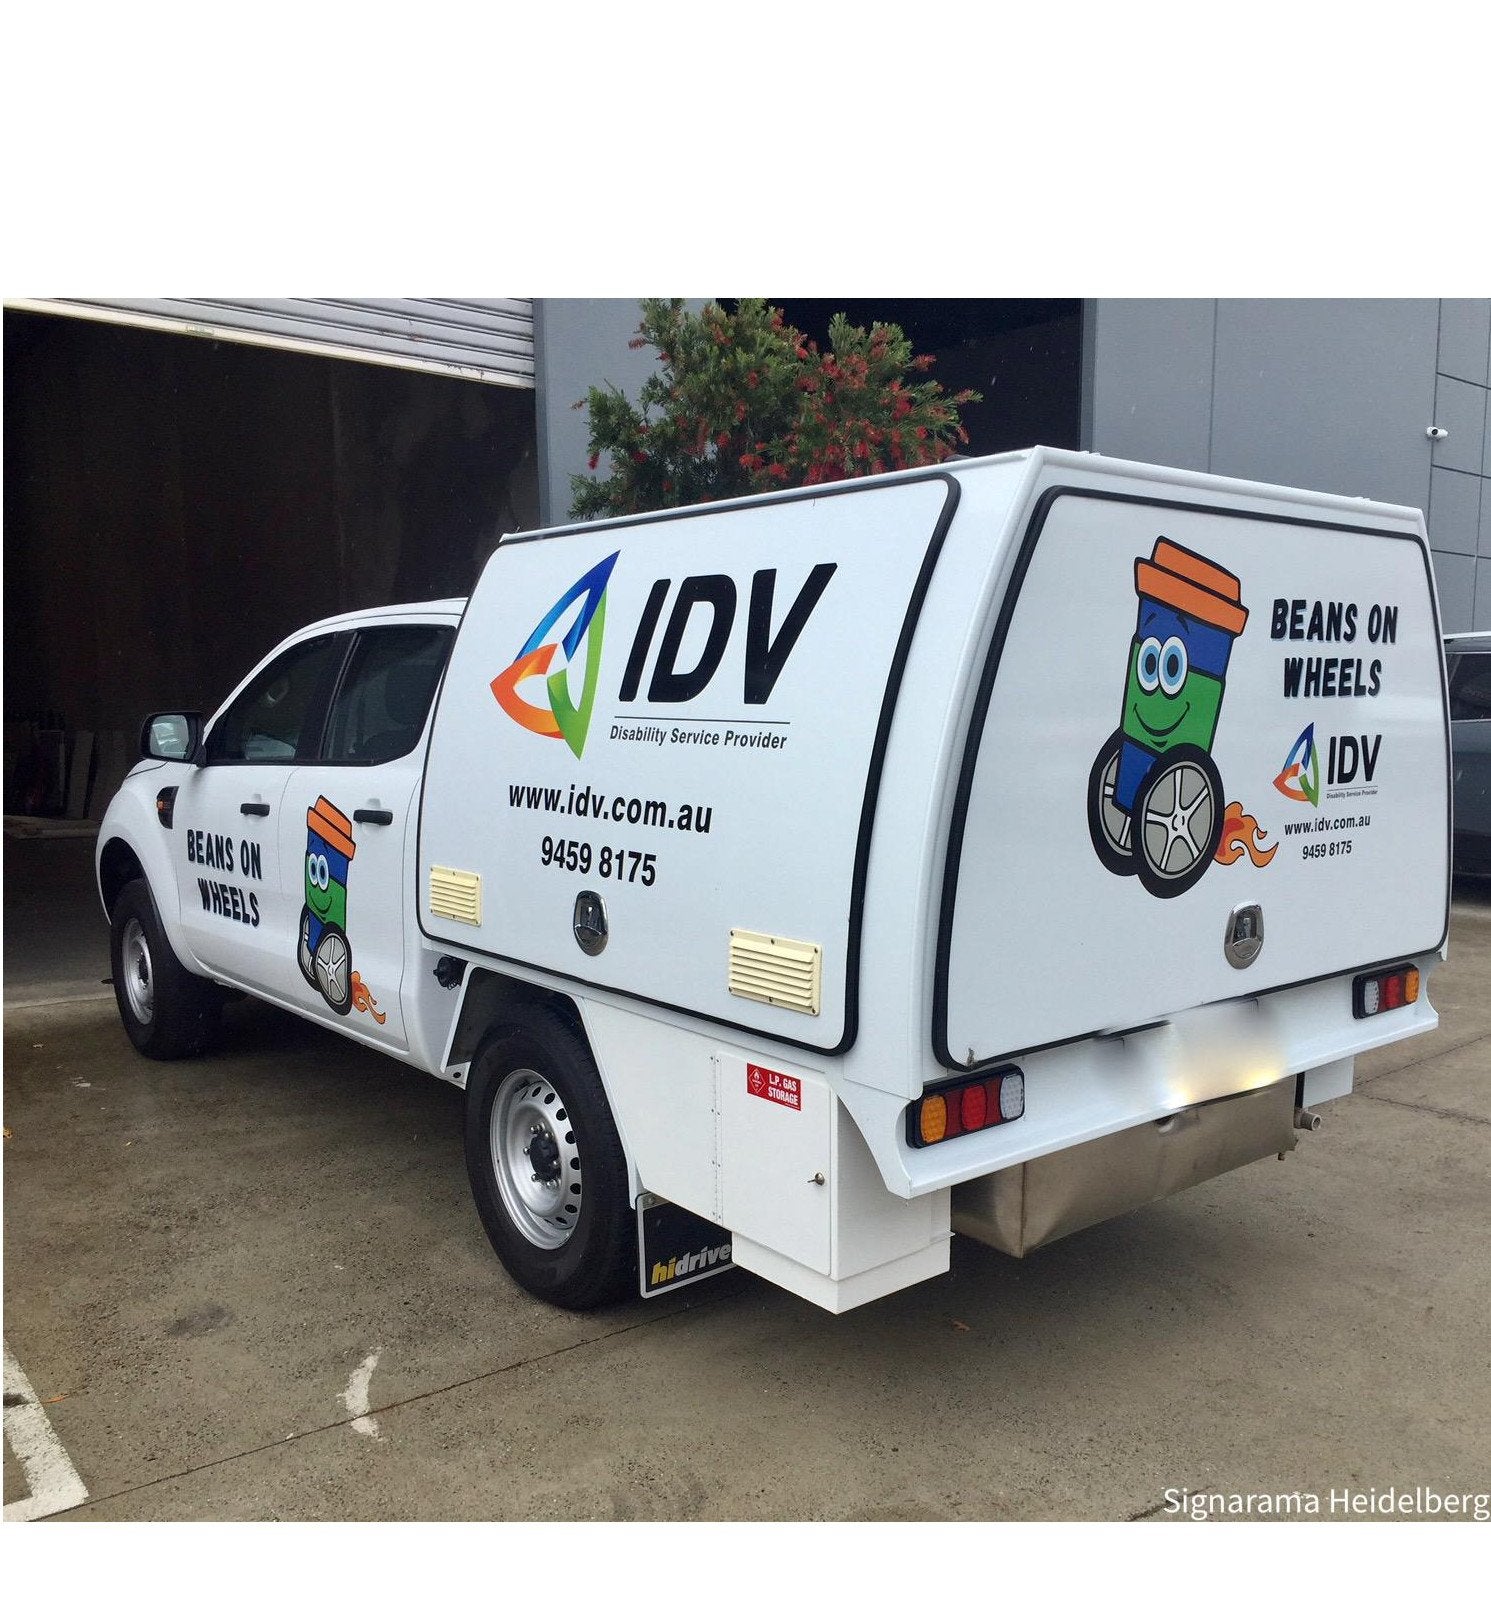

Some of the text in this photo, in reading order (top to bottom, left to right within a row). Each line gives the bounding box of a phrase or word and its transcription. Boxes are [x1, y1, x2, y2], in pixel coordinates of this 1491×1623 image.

[618, 562, 838, 705] IDV
[1270, 598, 1398, 643] BEANS ON
[1283, 656, 1382, 698] WHEELS
[609, 725, 787, 749] Disability Service Provider
[1327, 734, 1382, 785] IDV
[508, 783, 712, 834] www.idv.com.au
[1284, 813, 1371, 836] www.idv.com.au
[187, 829, 262, 880] BEANS ON
[541, 836, 657, 887] 9459 8175
[1302, 840, 1352, 860] 9459 8175
[197, 877, 260, 927] WHEELS
[767, 1085, 799, 1106] STORAGE
[783, 1078, 797, 1092] GAS
[651, 1243, 732, 1285] hidrive
